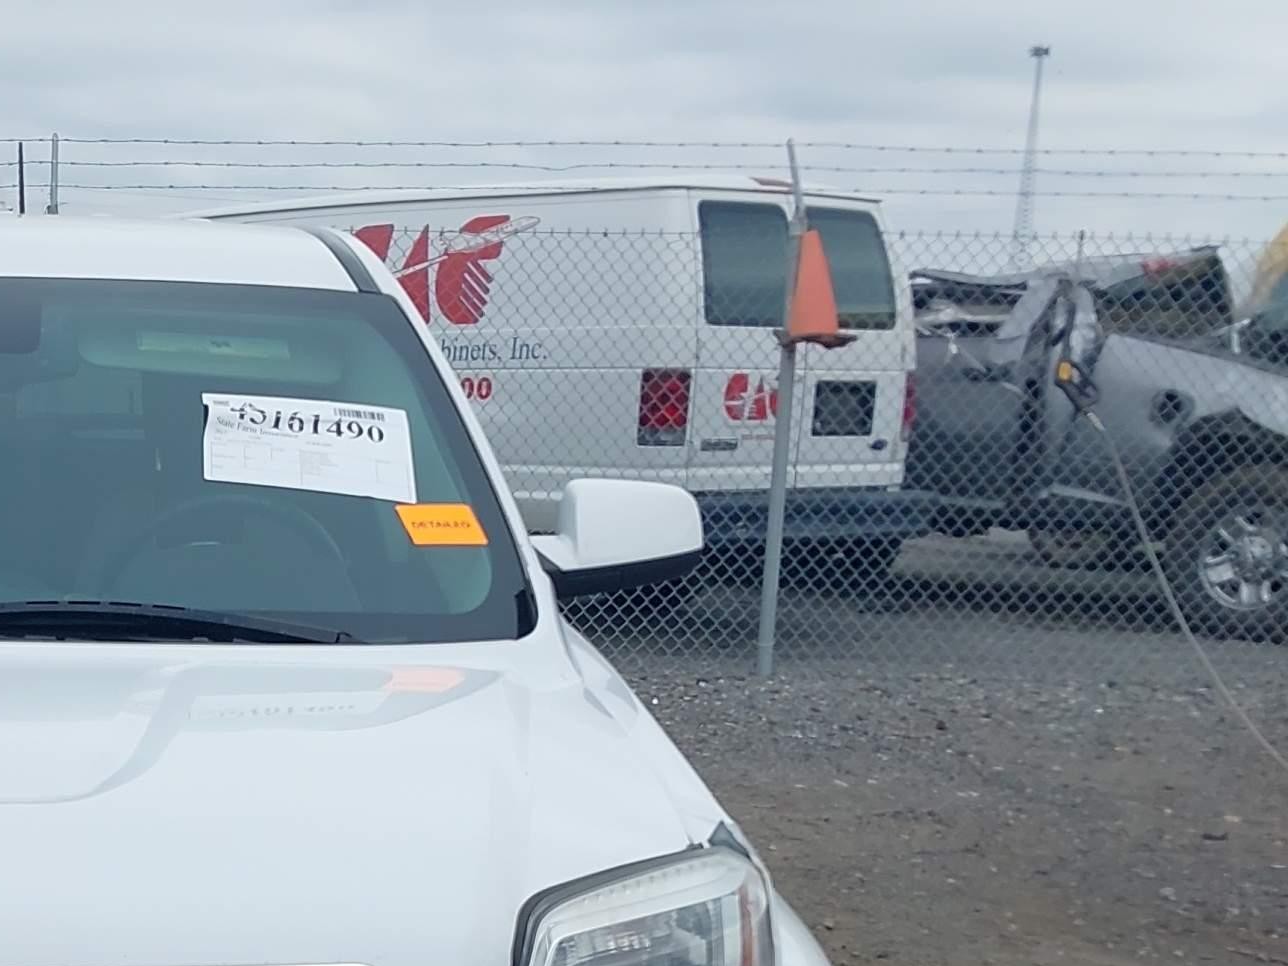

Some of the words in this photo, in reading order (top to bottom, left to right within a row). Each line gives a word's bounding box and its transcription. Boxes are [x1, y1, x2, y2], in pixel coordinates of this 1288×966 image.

[440, 338, 502, 363] binets,
[510, 337, 547, 361] Inc.
[230, 402, 384, 443] 45161490
